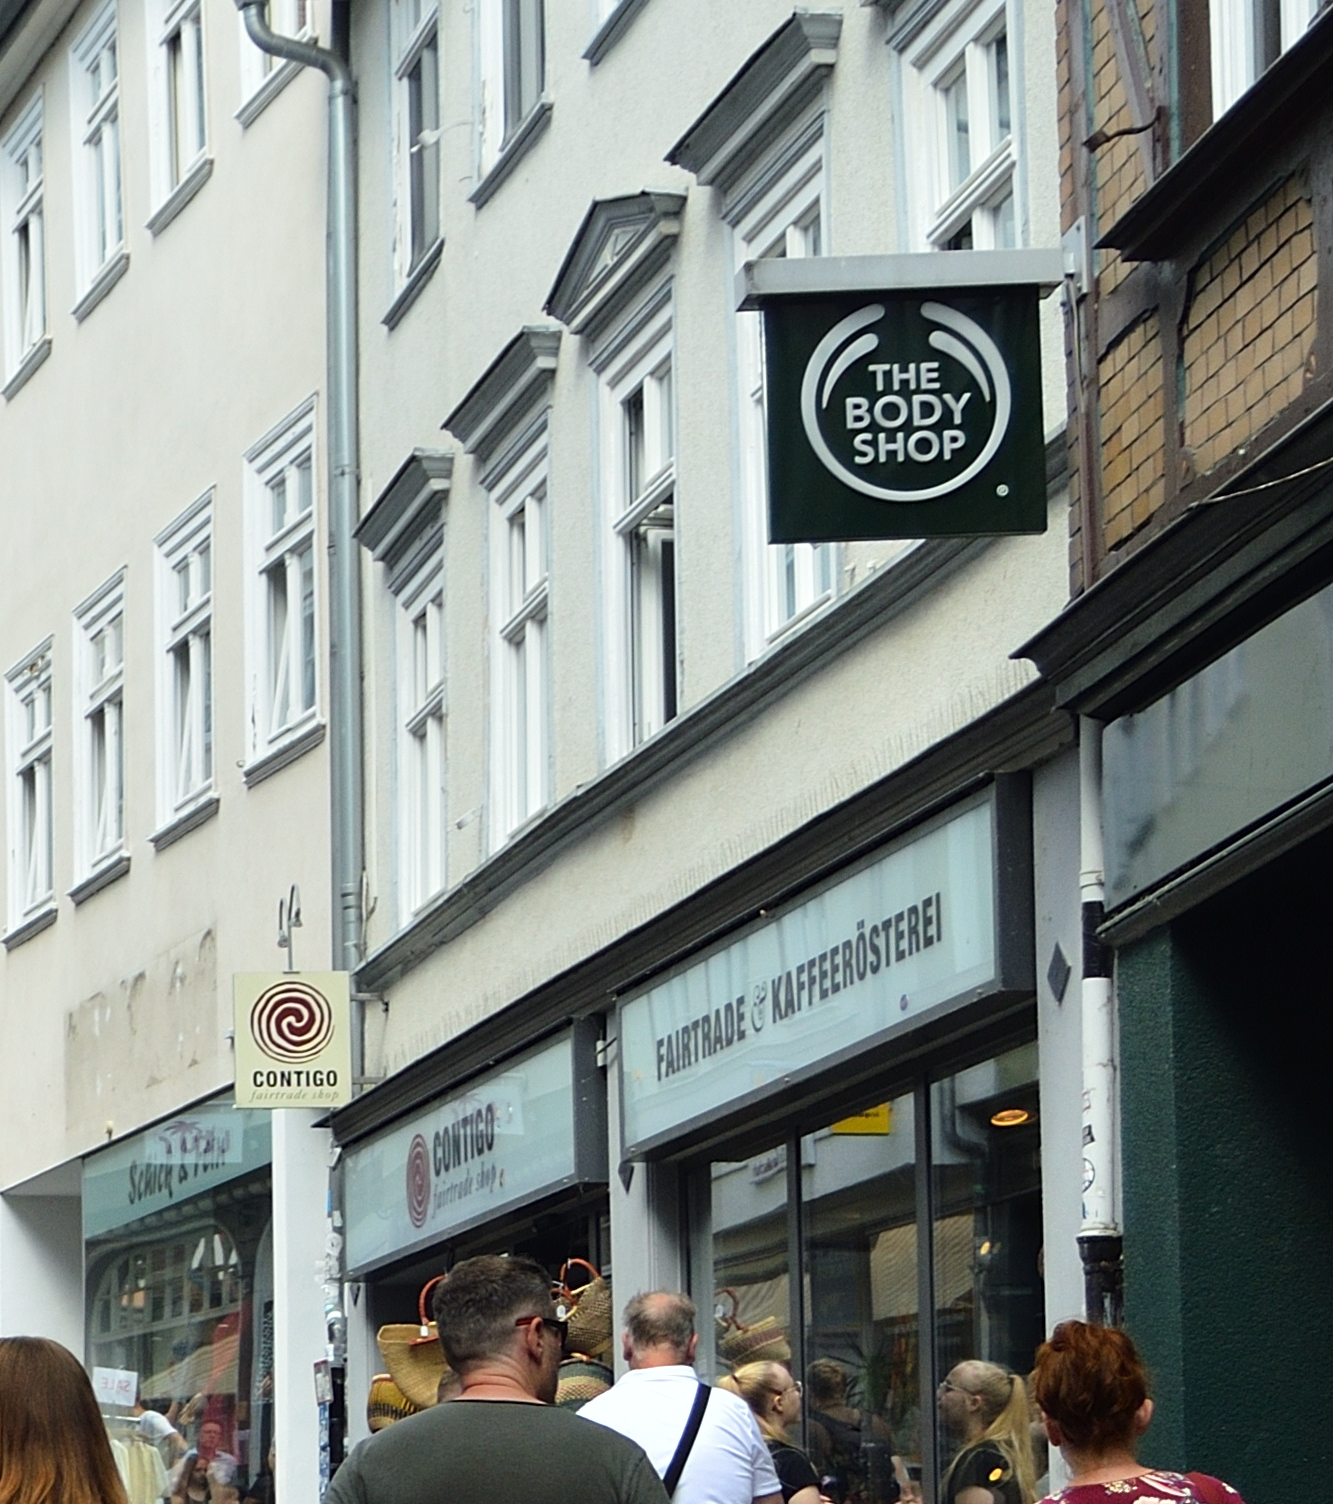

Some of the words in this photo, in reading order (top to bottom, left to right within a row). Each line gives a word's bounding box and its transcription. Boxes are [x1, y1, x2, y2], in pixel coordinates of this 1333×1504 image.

[867, 362, 941, 392] THE
[845, 392, 972, 429] BODY
[853, 430, 966, 464] SHOP
[656, 995, 746, 1082] FAIRTRADE
[771, 892, 942, 1024] KAFFEERÖSTEREI
[253, 1070, 338, 1087] CONTIGO
[249, 1089, 307, 1103] fairtrade
[312, 1089, 339, 1102] shop
[433, 1103, 495, 1177] CONTIGO
